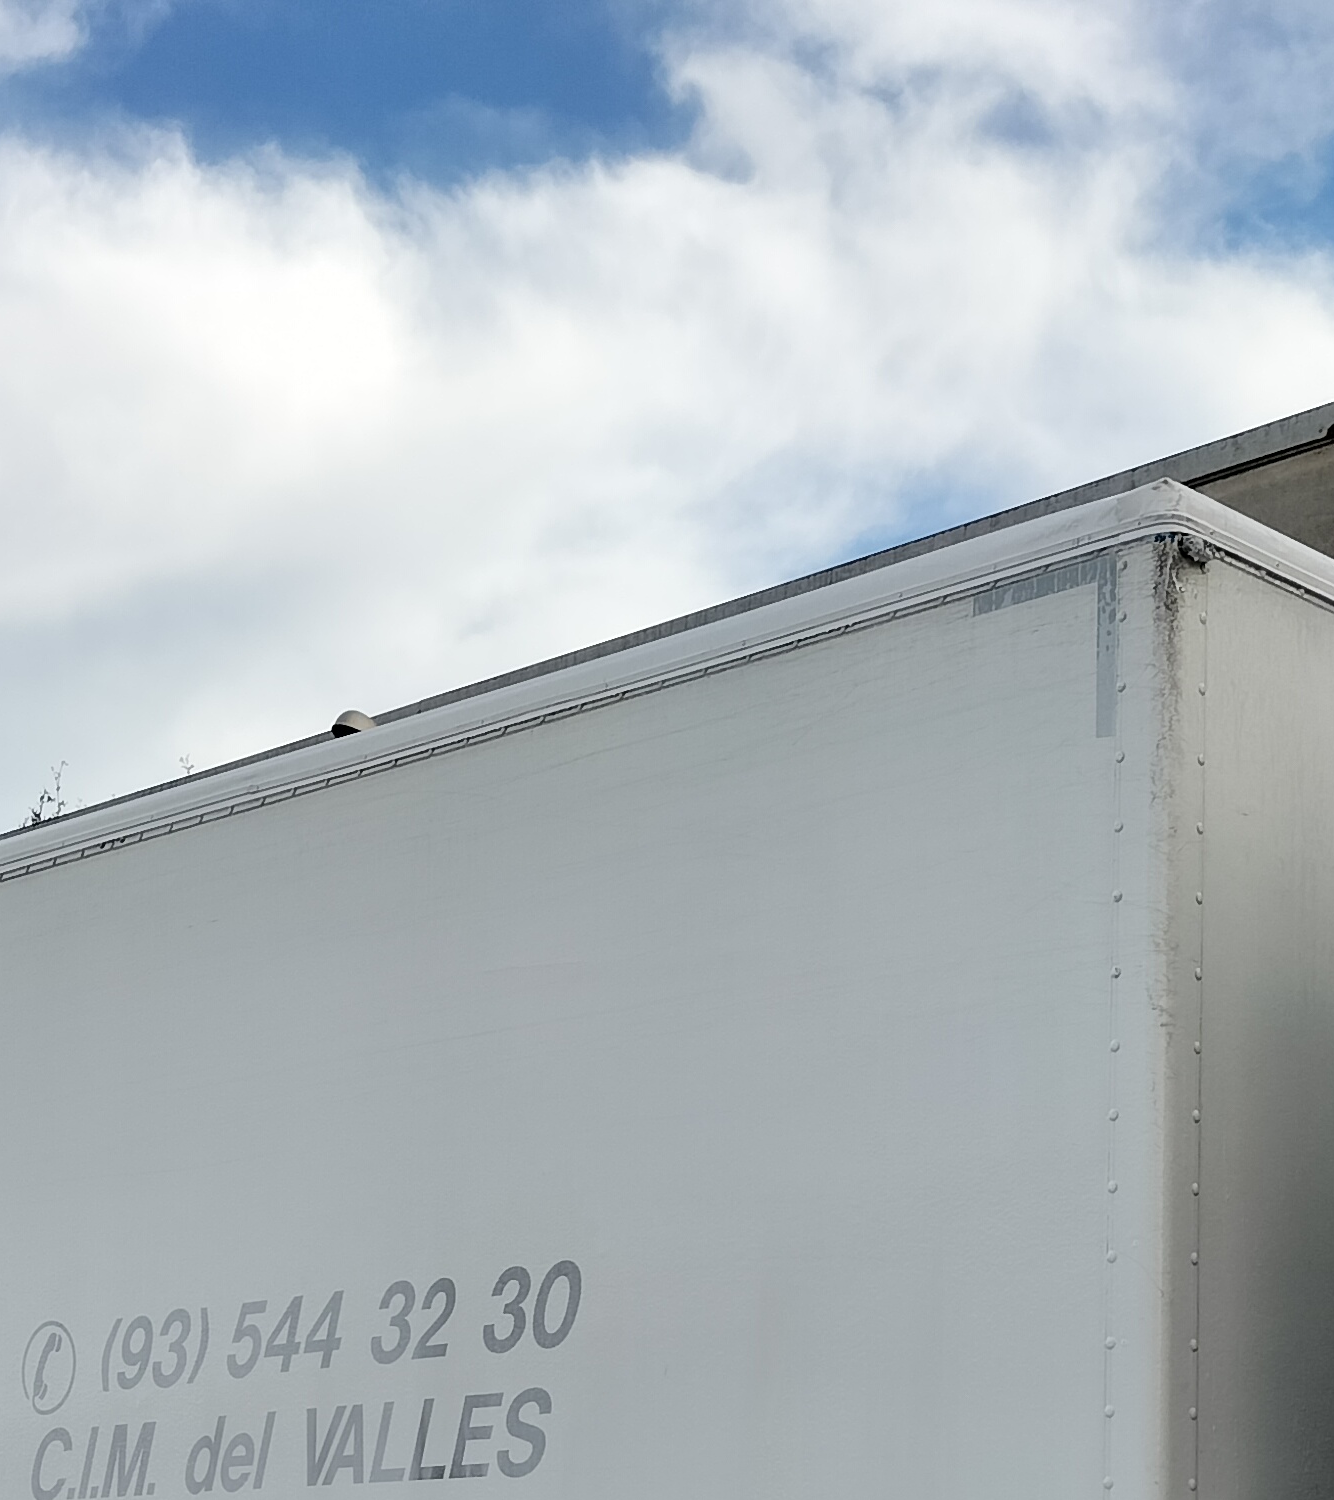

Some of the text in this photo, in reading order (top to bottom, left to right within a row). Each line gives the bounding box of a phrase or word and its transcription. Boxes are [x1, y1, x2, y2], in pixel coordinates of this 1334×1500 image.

[101, 1260, 582, 1392] (93) 544 32 30
[184, 1411, 276, 1495] del
[306, 1387, 553, 1488] VALLES
